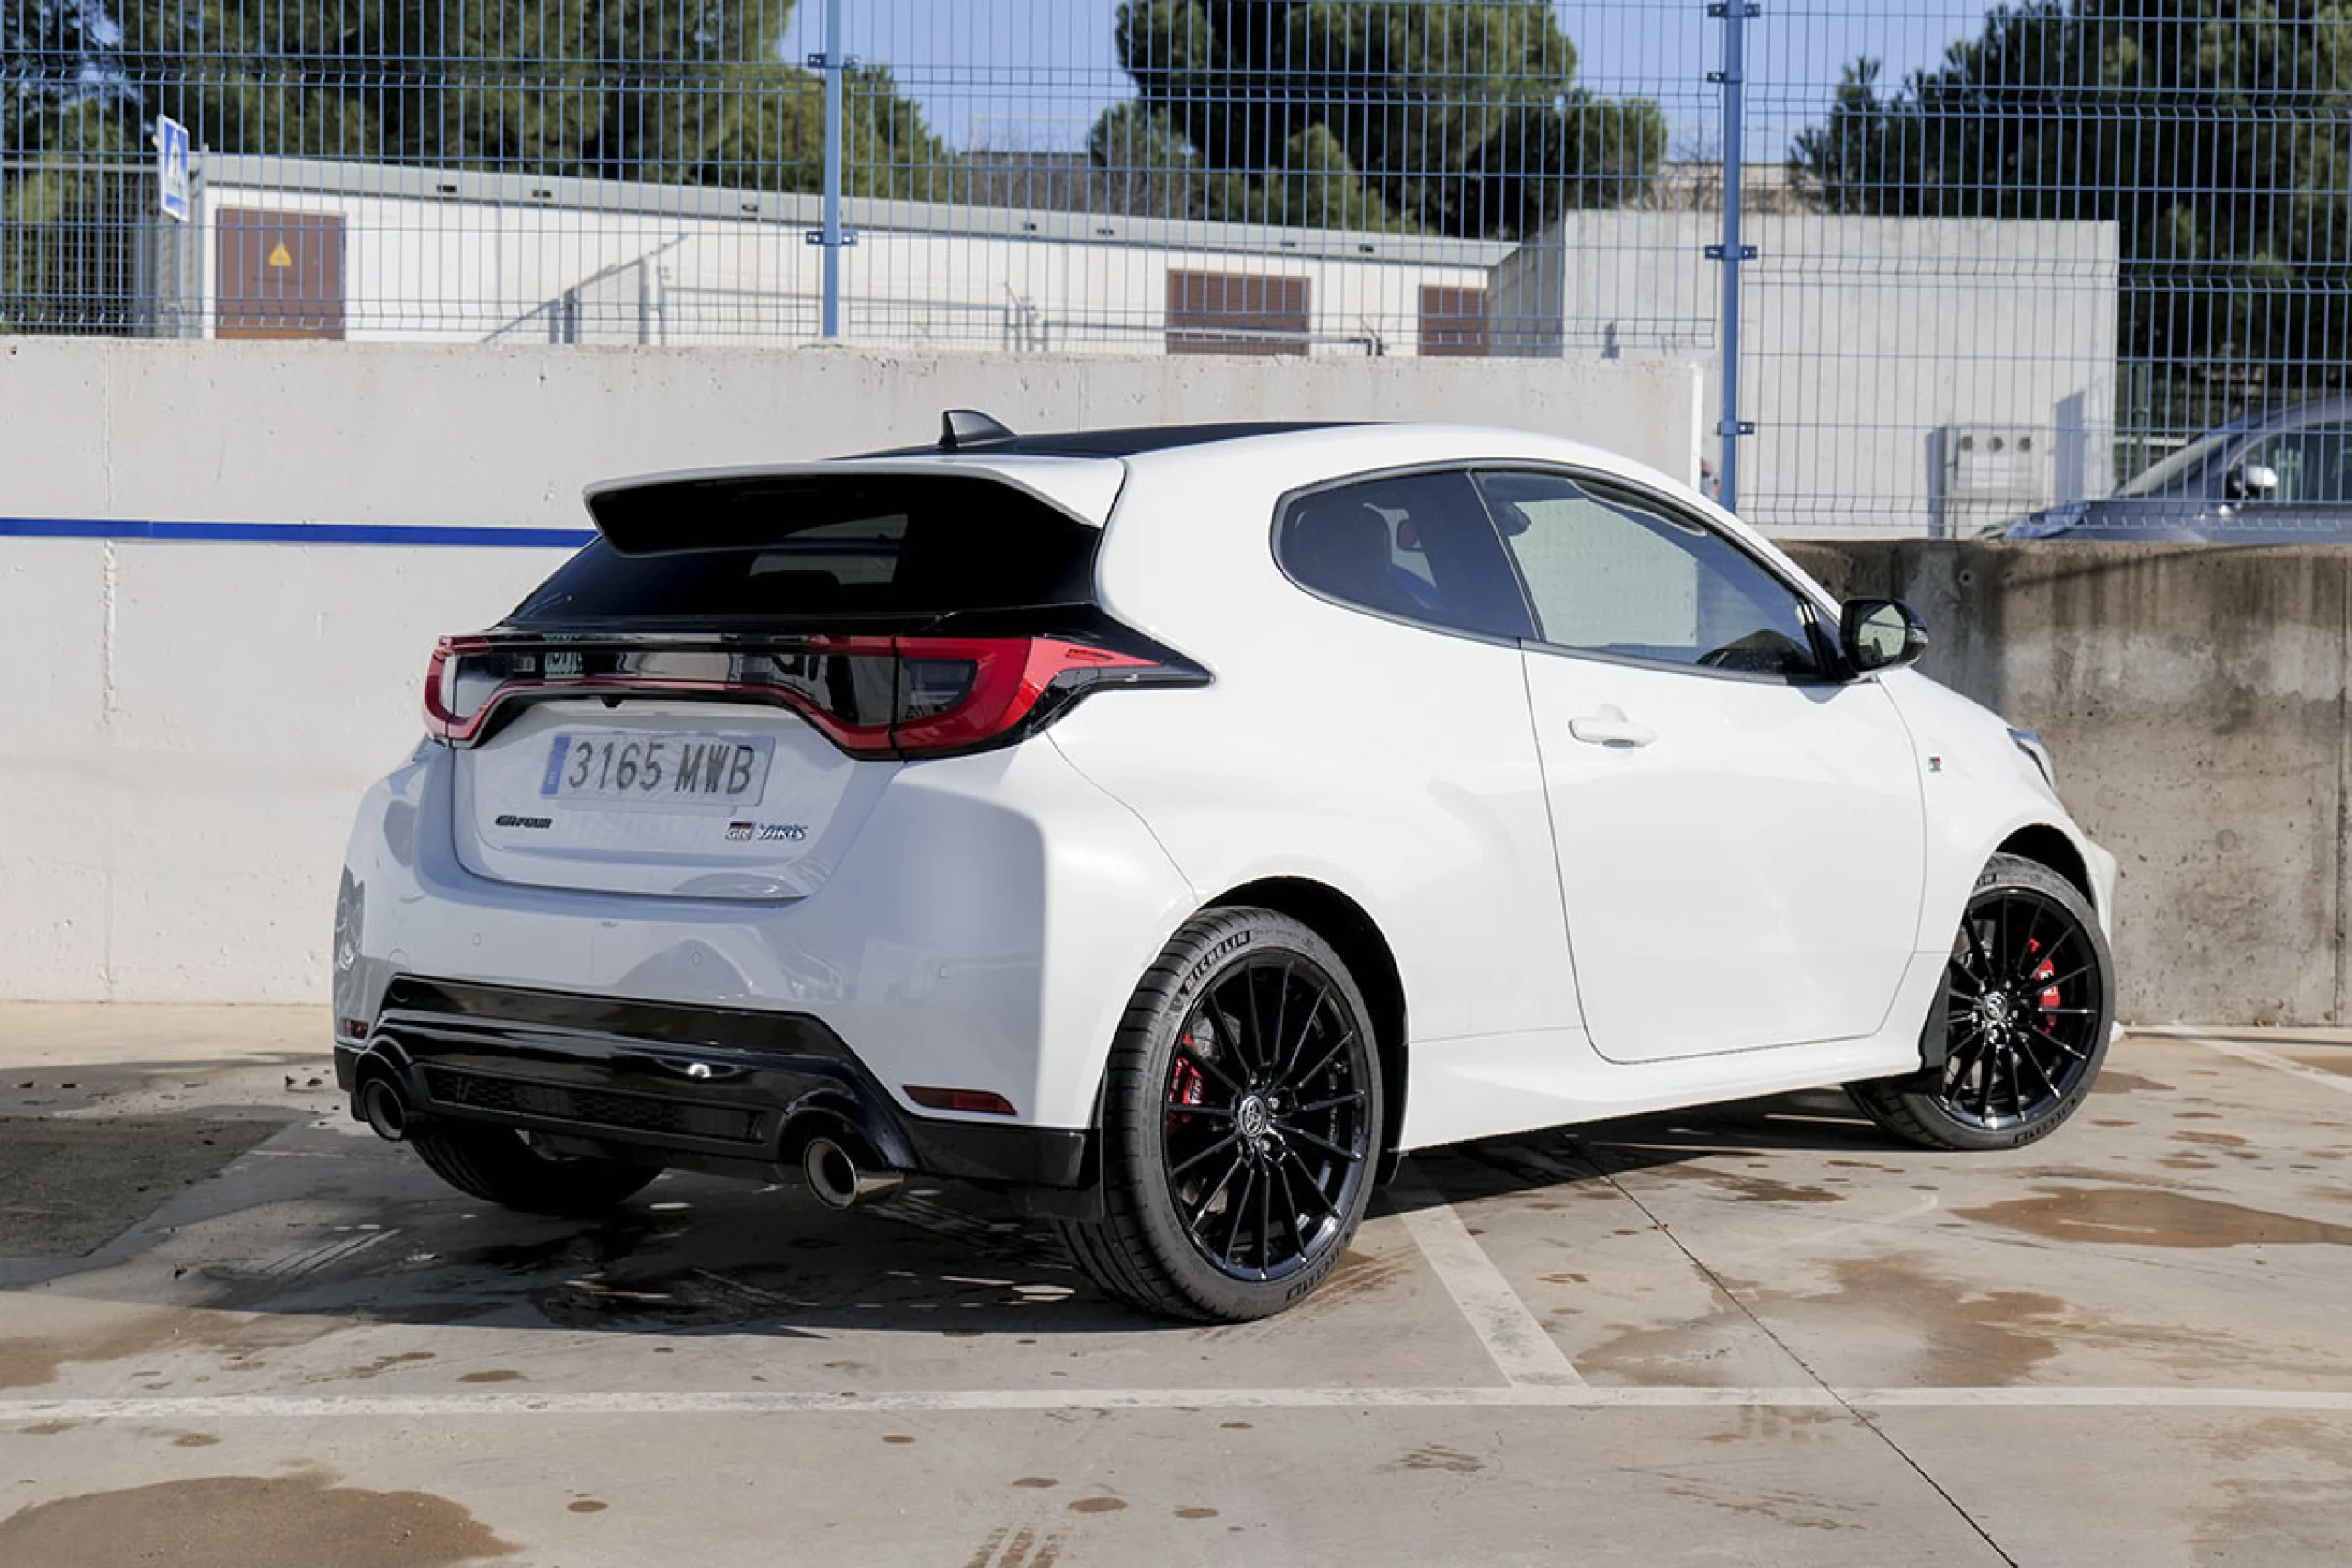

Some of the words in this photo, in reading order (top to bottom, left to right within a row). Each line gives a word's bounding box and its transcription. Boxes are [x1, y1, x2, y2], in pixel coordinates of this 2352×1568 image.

[568, 742, 665, 791] 3165
[674, 743, 754, 794] MWB
[1182, 931, 1250, 992] MICHELIN
